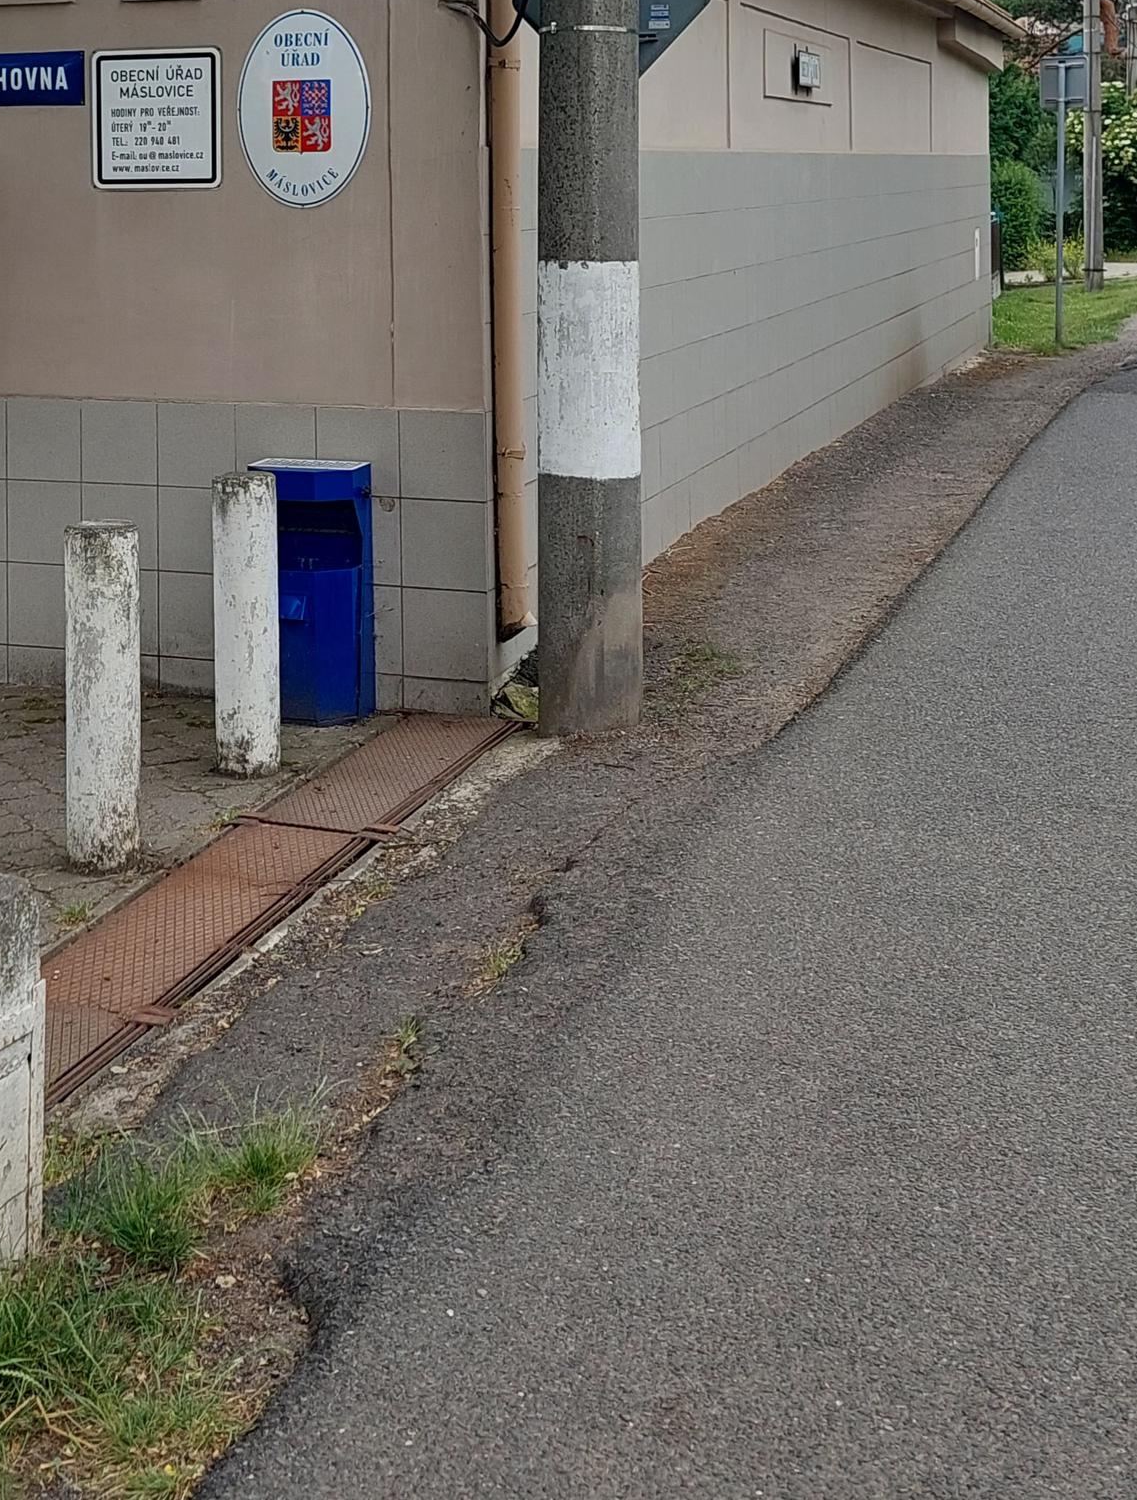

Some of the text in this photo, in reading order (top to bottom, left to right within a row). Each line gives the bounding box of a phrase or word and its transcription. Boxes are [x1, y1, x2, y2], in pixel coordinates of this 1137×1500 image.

[274, 28, 330, 47] OBECNÍ
[281, 49, 320, 67] ÚŘAD
[110, 64, 203, 83] OBECNÍ ÚŘAD
[120, 83, 194, 99] MÁSLOVICE
[111, 108, 137, 118] HODINY
[140, 107, 154, 117] PRO
[111, 120, 133, 133] ÚTERÝ
[134, 136, 148, 146] 220
[150, 136, 164, 146] 940
[167, 135, 180, 145] 481
[266, 167, 339, 197] MÁSLOVICE
